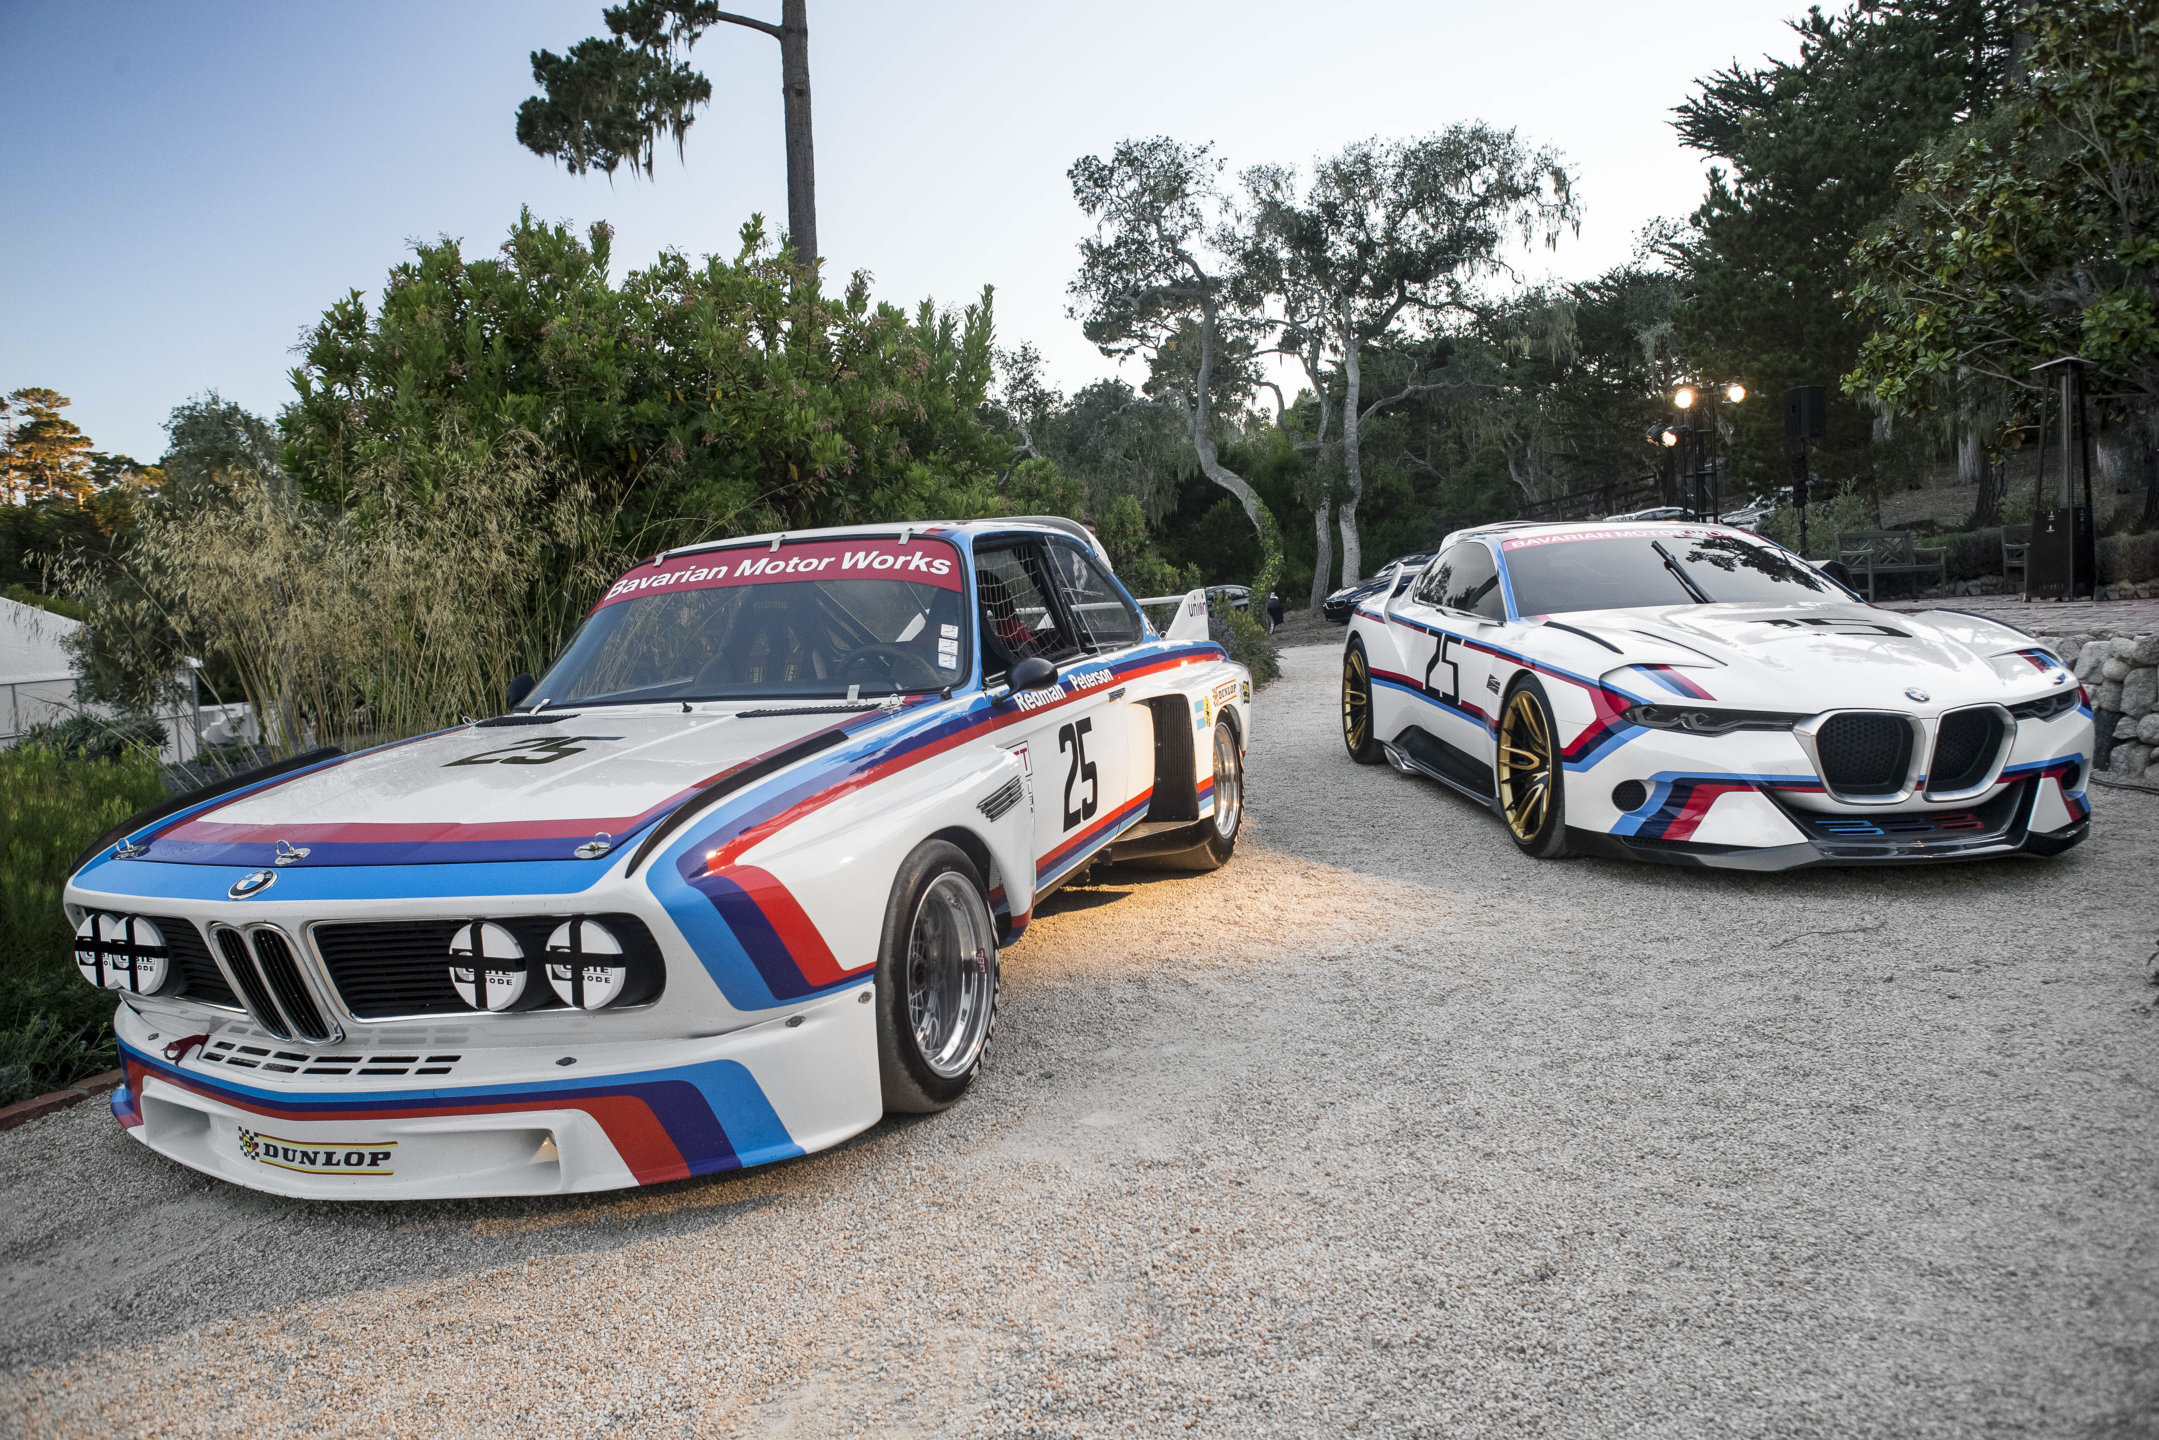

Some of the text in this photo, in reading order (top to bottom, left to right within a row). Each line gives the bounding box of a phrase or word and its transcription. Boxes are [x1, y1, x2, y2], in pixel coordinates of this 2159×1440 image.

[1511, 531, 1612, 548] BAVARIAN
[604, 551, 952, 601] Bavarian Motor Works
[1068, 668, 1114, 691] Peterson
[1425, 628, 1460, 705] 25
[440, 736, 627, 767] 25
[1059, 717, 1098, 833] 25
[487, 977, 513, 986] ODE
[263, 1142, 391, 1167] DUNLOP
